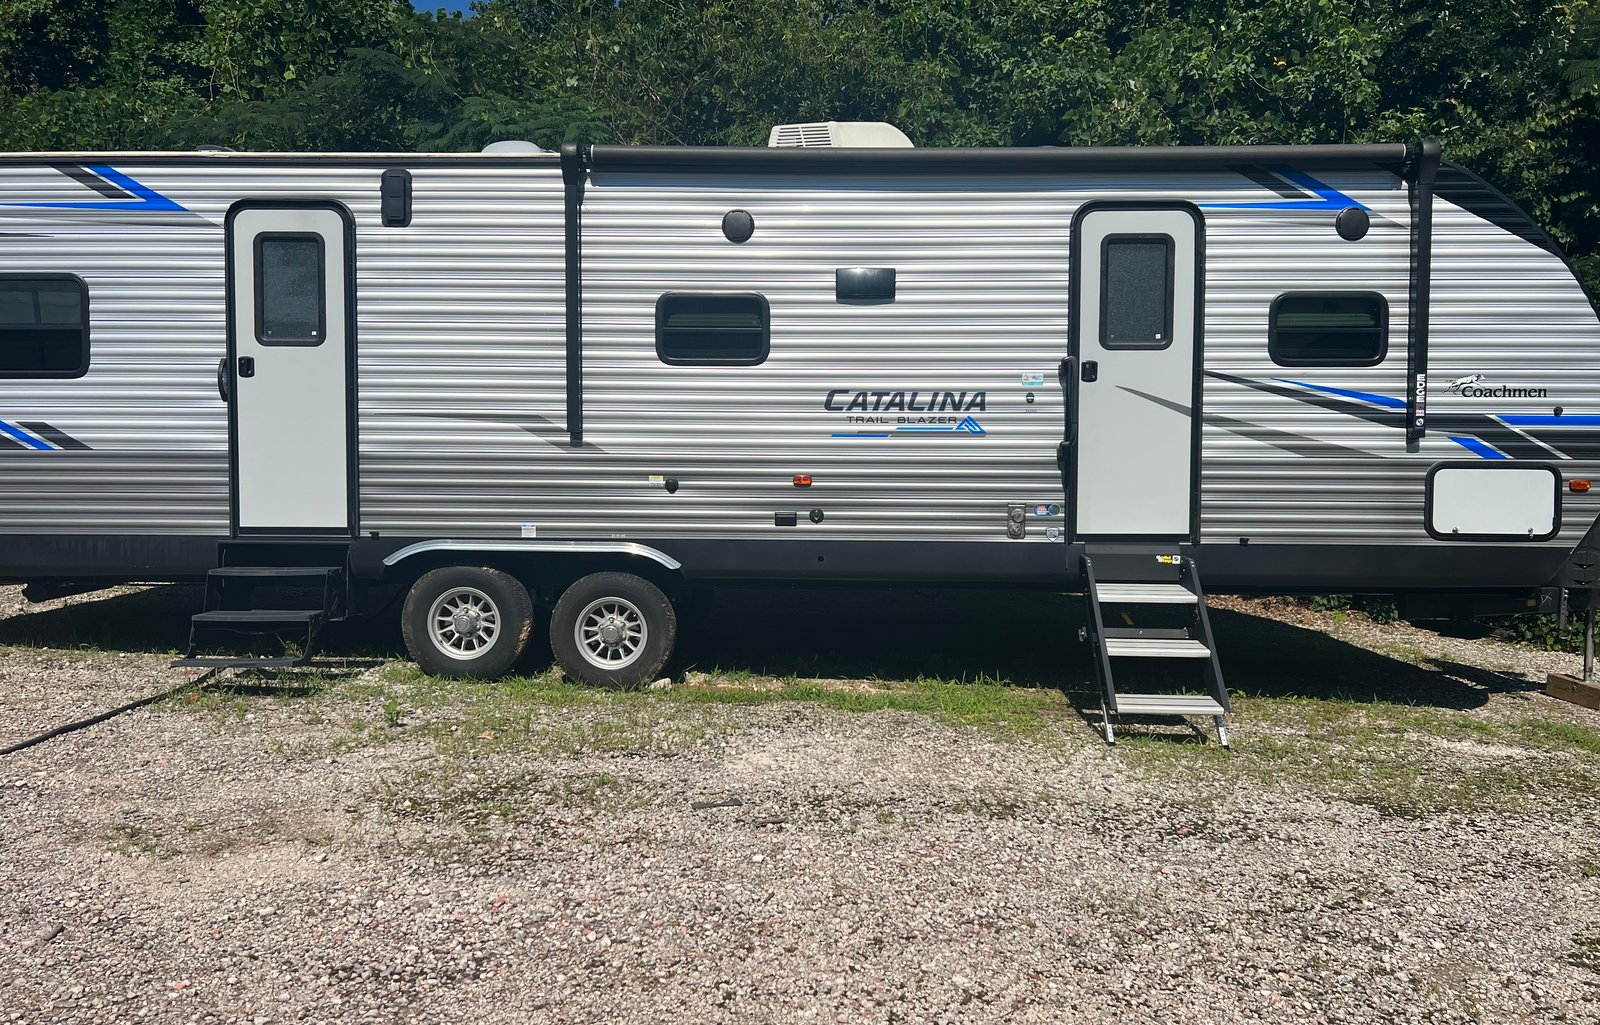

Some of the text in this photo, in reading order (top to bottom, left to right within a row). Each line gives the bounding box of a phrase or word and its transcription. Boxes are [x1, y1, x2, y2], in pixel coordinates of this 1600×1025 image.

[1416, 373, 1426, 403] EDGE
[1461, 385, 1547, 398] Coachmen
[824, 389, 987, 412] CATALINA
[846, 416, 957, 424] TRAIL BLAZER
